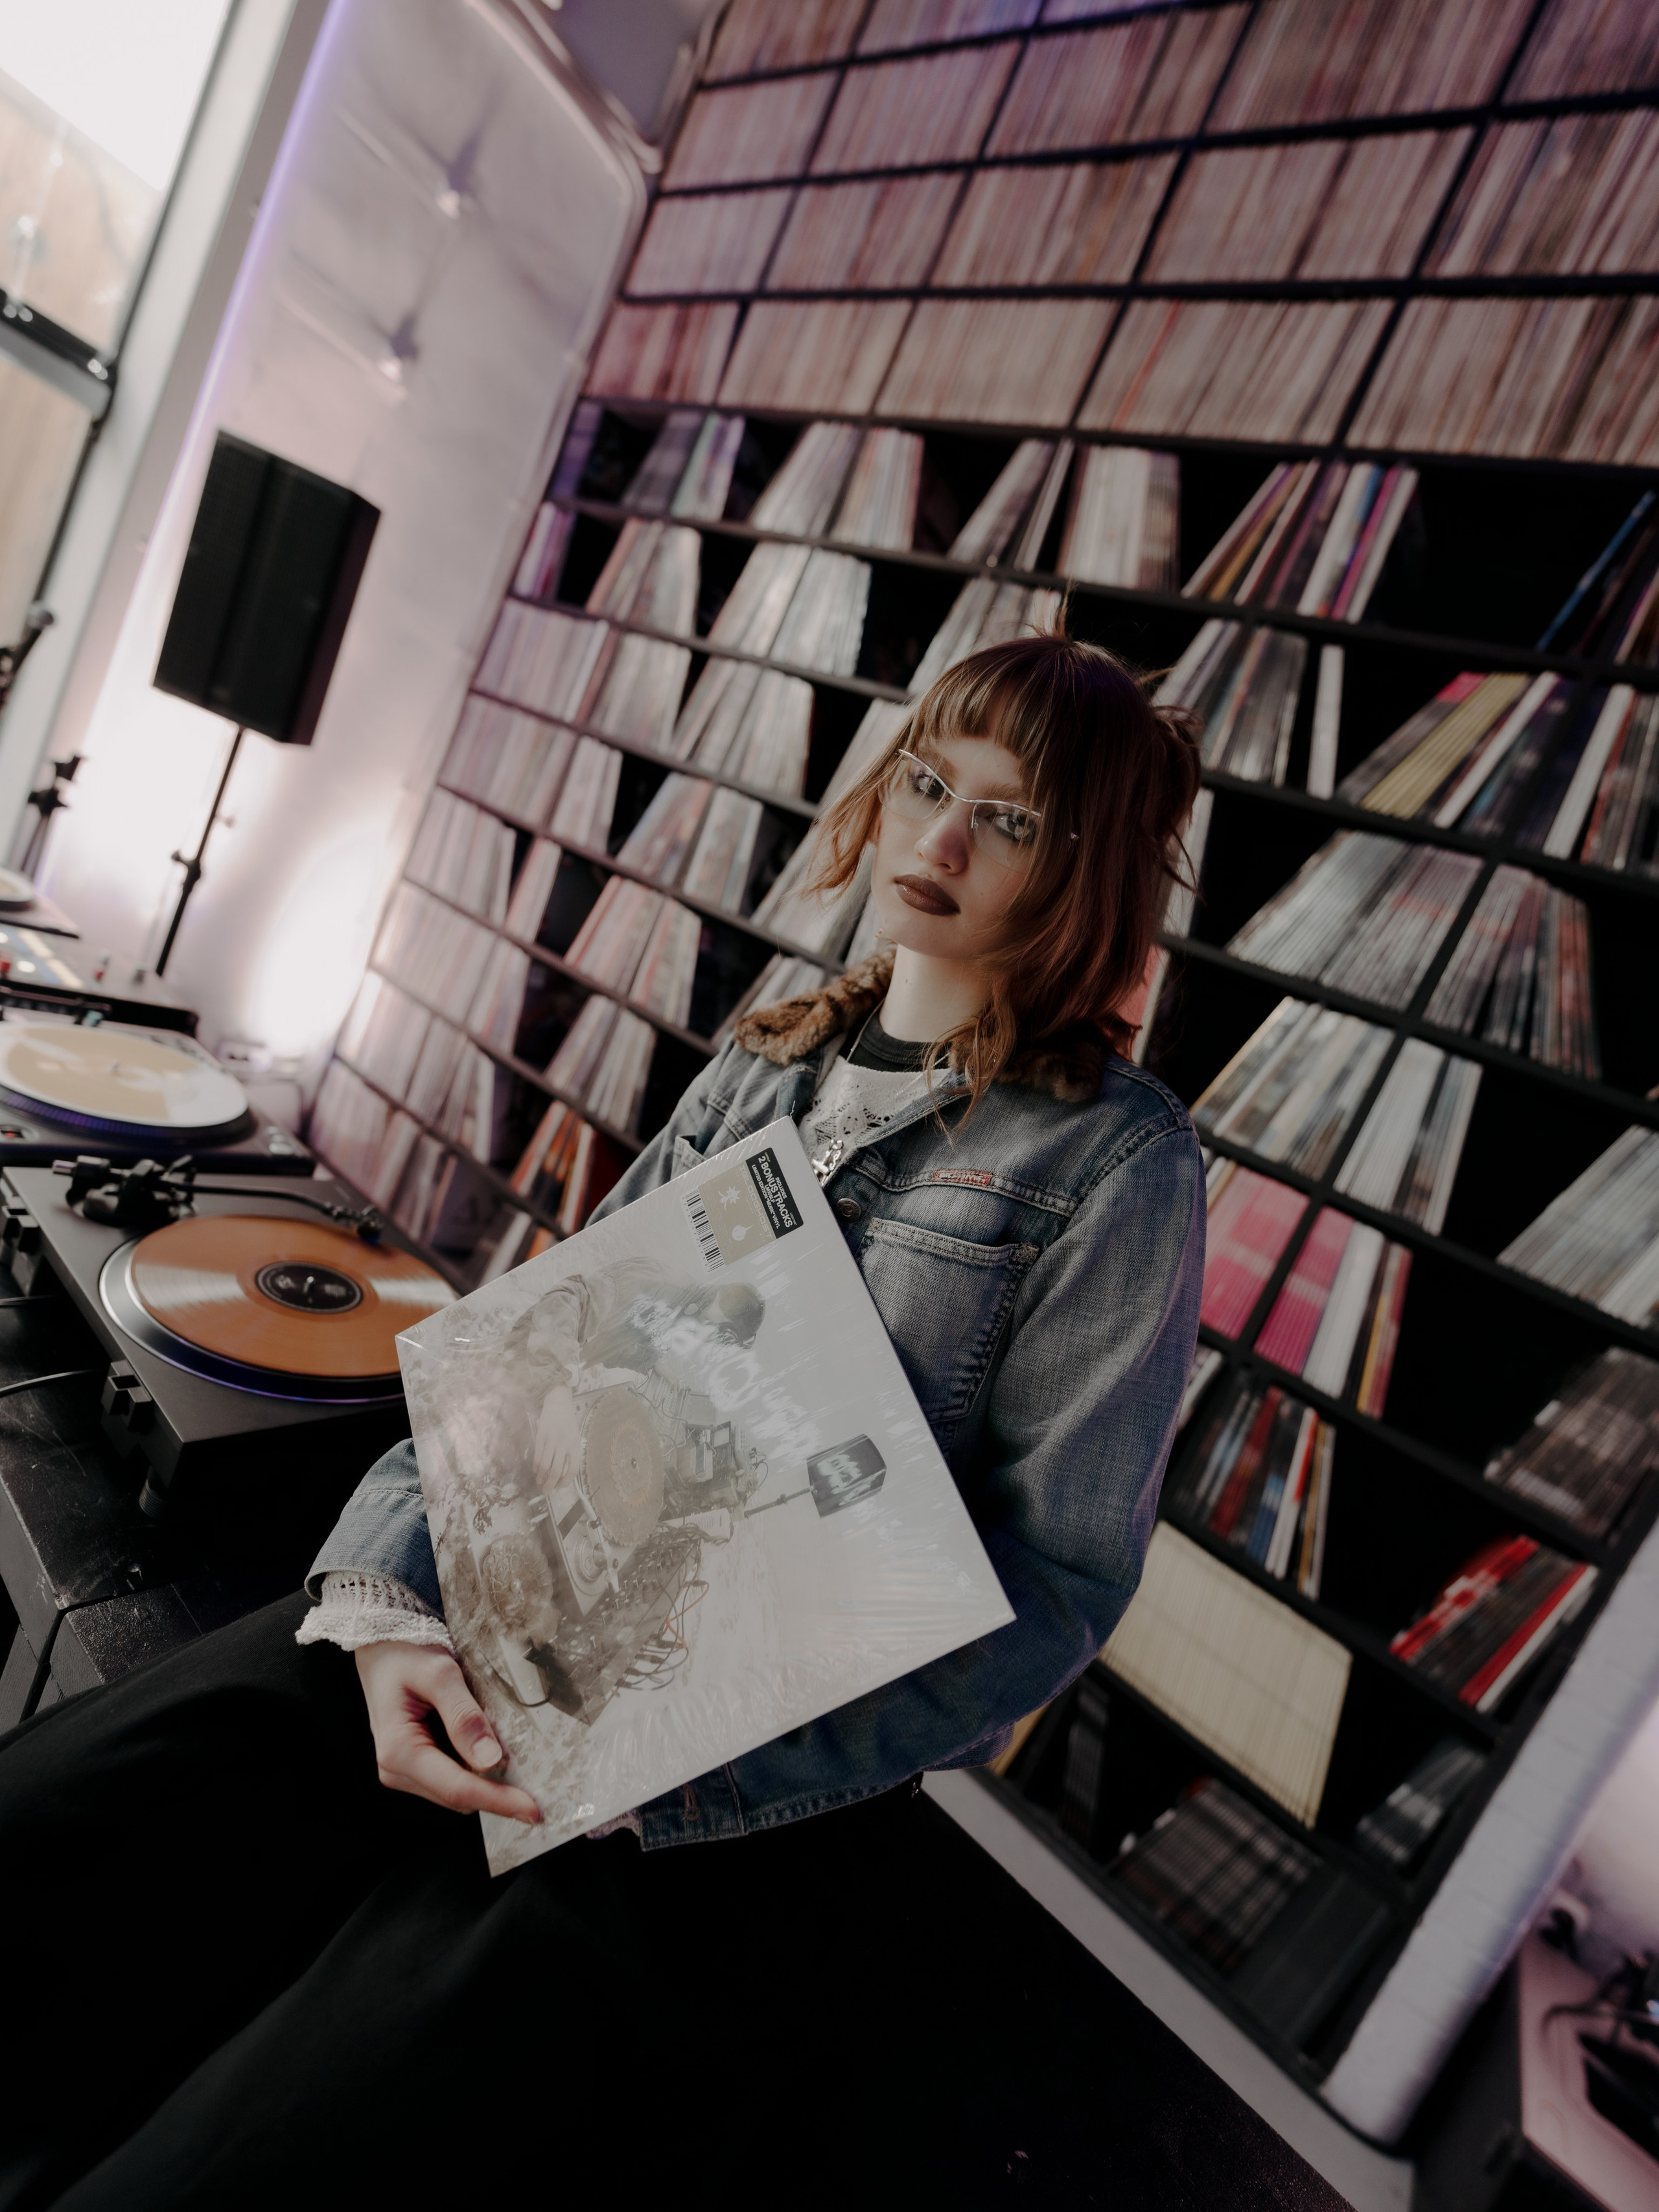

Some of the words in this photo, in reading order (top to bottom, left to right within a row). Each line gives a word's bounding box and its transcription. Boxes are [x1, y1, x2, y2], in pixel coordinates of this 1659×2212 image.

[758, 1155, 767, 1163] 2
[760, 1161, 779, 1193] BONUS
[764, 1183, 775, 1203] LM105LP
[774, 1176, 787, 1199] INCLUDES
[738, 1164, 772, 1238] IGLOOGHOST
[751, 1163, 761, 1182] LIMITED
[758, 1180, 769, 1199] EDITION
[771, 1214, 780, 1229] VINYL
[773, 1191, 793, 1228] TRACKS
